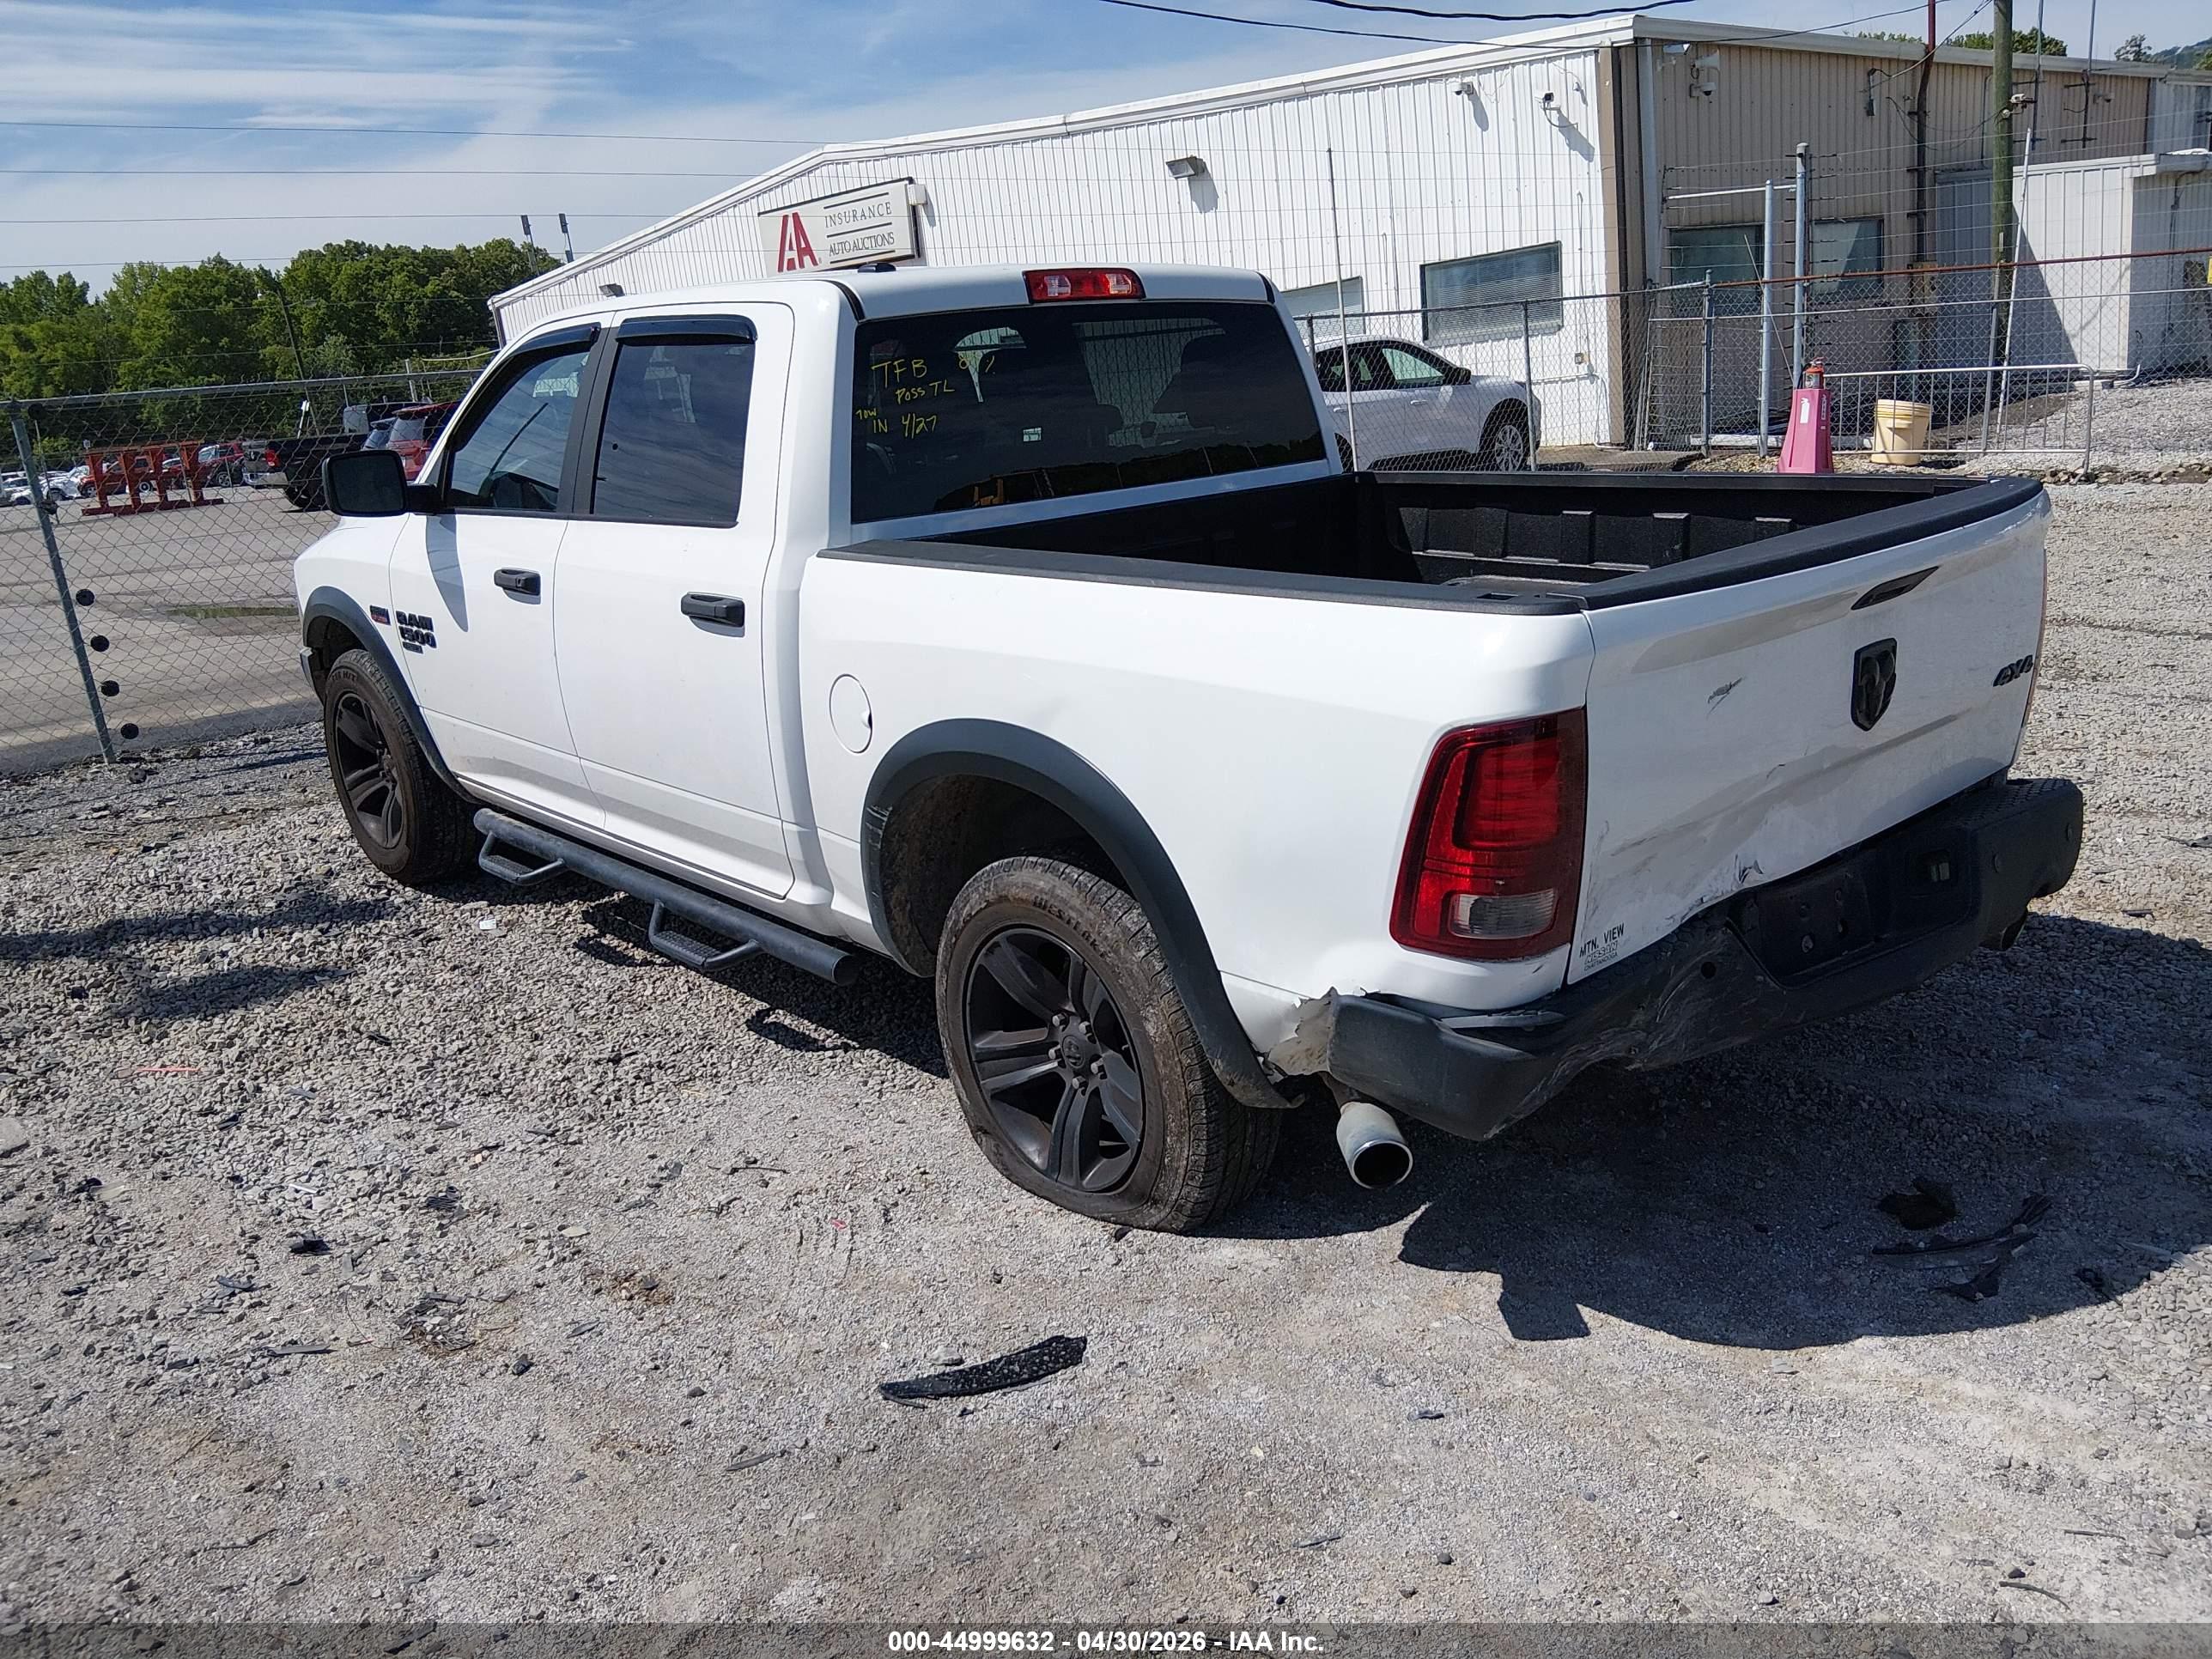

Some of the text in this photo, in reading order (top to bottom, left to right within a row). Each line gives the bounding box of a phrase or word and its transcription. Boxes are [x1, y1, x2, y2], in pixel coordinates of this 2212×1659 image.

[824, 201, 892, 228] INSURANCE
[829, 231, 895, 258] AUTO AUCTIONS
[928, 379, 955, 397] TL
[873, 413, 938, 439] IN 4/27
[395, 610, 434, 632] RAM
[398, 625, 437, 649] 1500
[1579, 922, 1625, 958] MTN. VIEW
